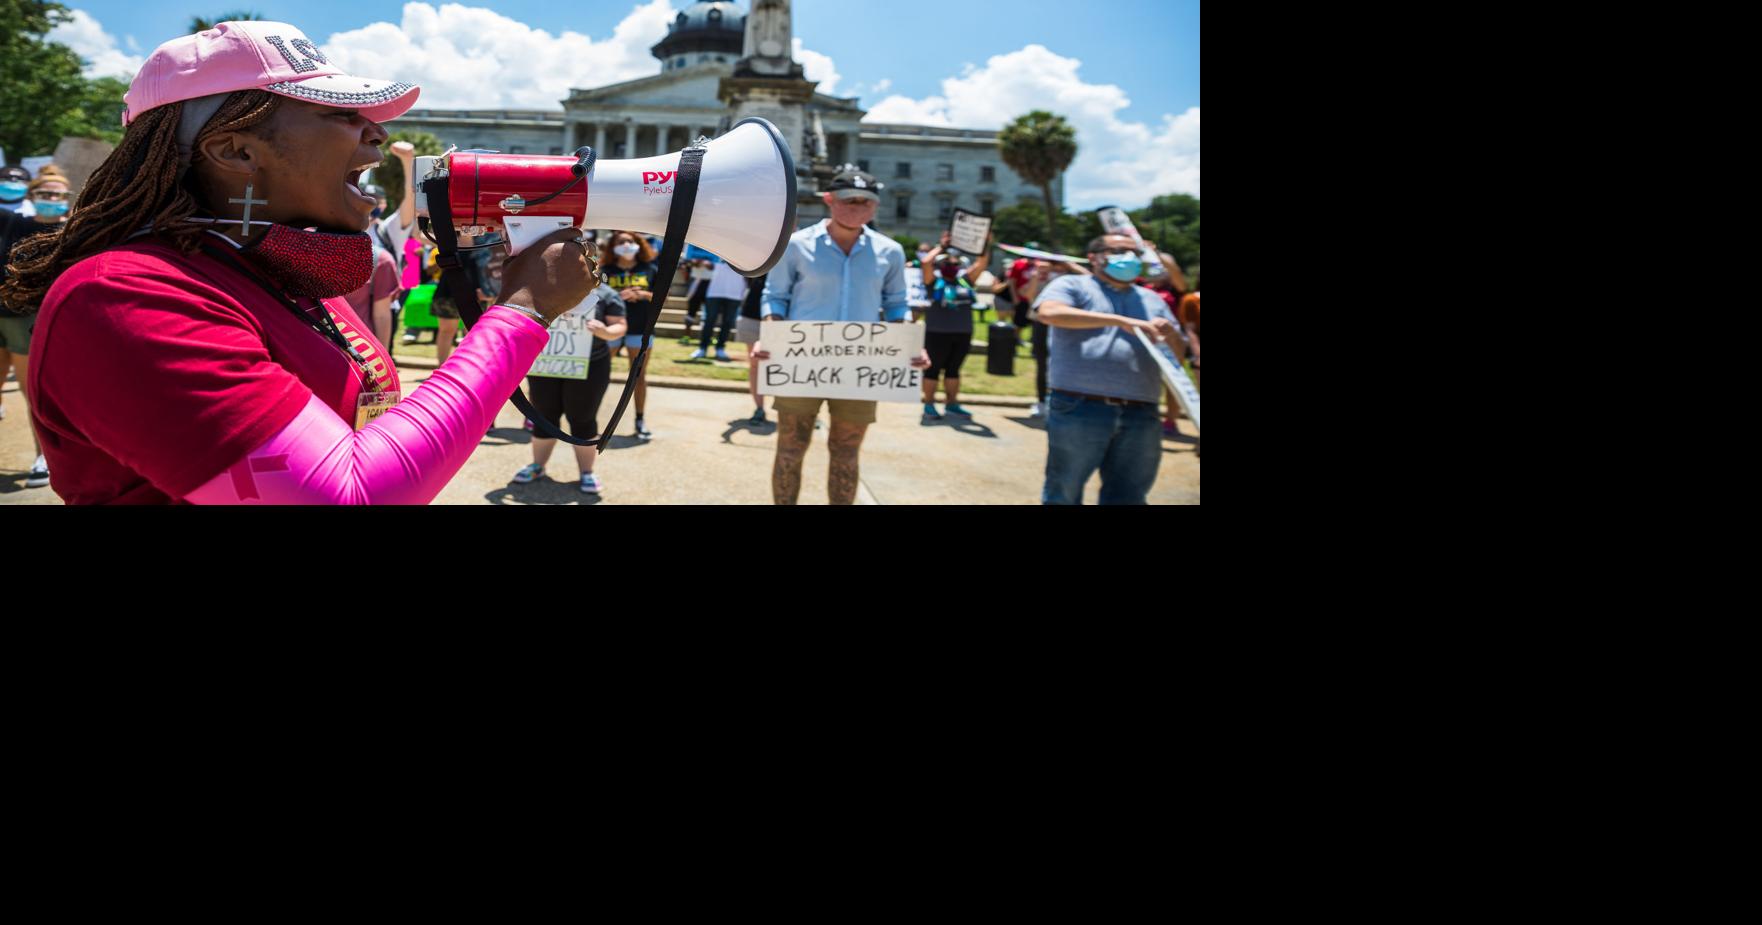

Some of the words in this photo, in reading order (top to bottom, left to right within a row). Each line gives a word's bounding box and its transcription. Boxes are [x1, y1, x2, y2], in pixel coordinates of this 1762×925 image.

[787, 322, 888, 345] STOP
[784, 345, 903, 358] MURDERING
[765, 363, 844, 388] BLACK
[855, 365, 920, 389] PEOPLE
